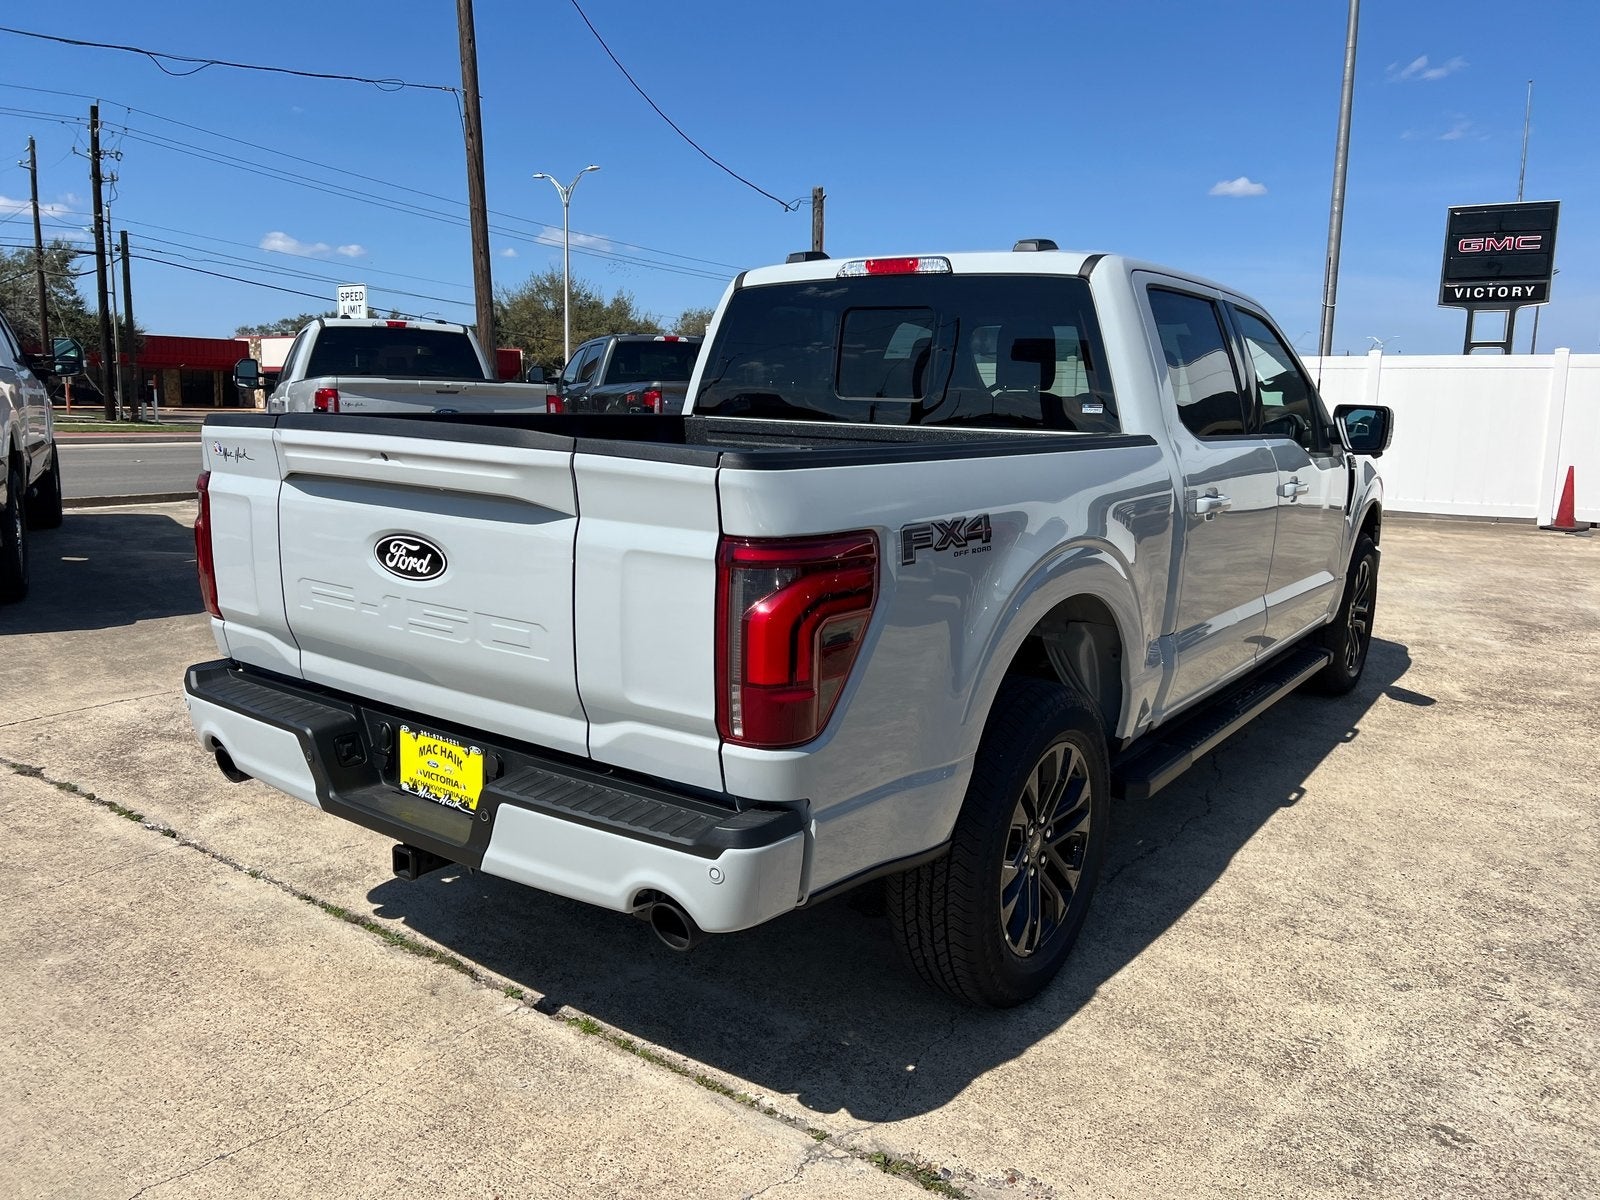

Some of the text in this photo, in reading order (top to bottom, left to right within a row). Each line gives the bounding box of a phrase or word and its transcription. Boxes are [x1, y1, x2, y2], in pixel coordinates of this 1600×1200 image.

[1458, 235, 1542, 253] GMC
[340, 291, 364, 302] SPEED
[1454, 285, 1535, 299] VICTORY
[342, 304, 362, 315] LIMIT
[900, 513, 992, 567] FX4
[385, 539, 432, 575] Ford
[953, 545, 992, 558] OFF ROAD
[298, 577, 550, 662] F-150
[418, 744, 439, 757] MAC
[440, 745, 463, 771] HAIK
[422, 769, 460, 790] VICTORIA
[417, 786, 468, 811] Mac Haik
